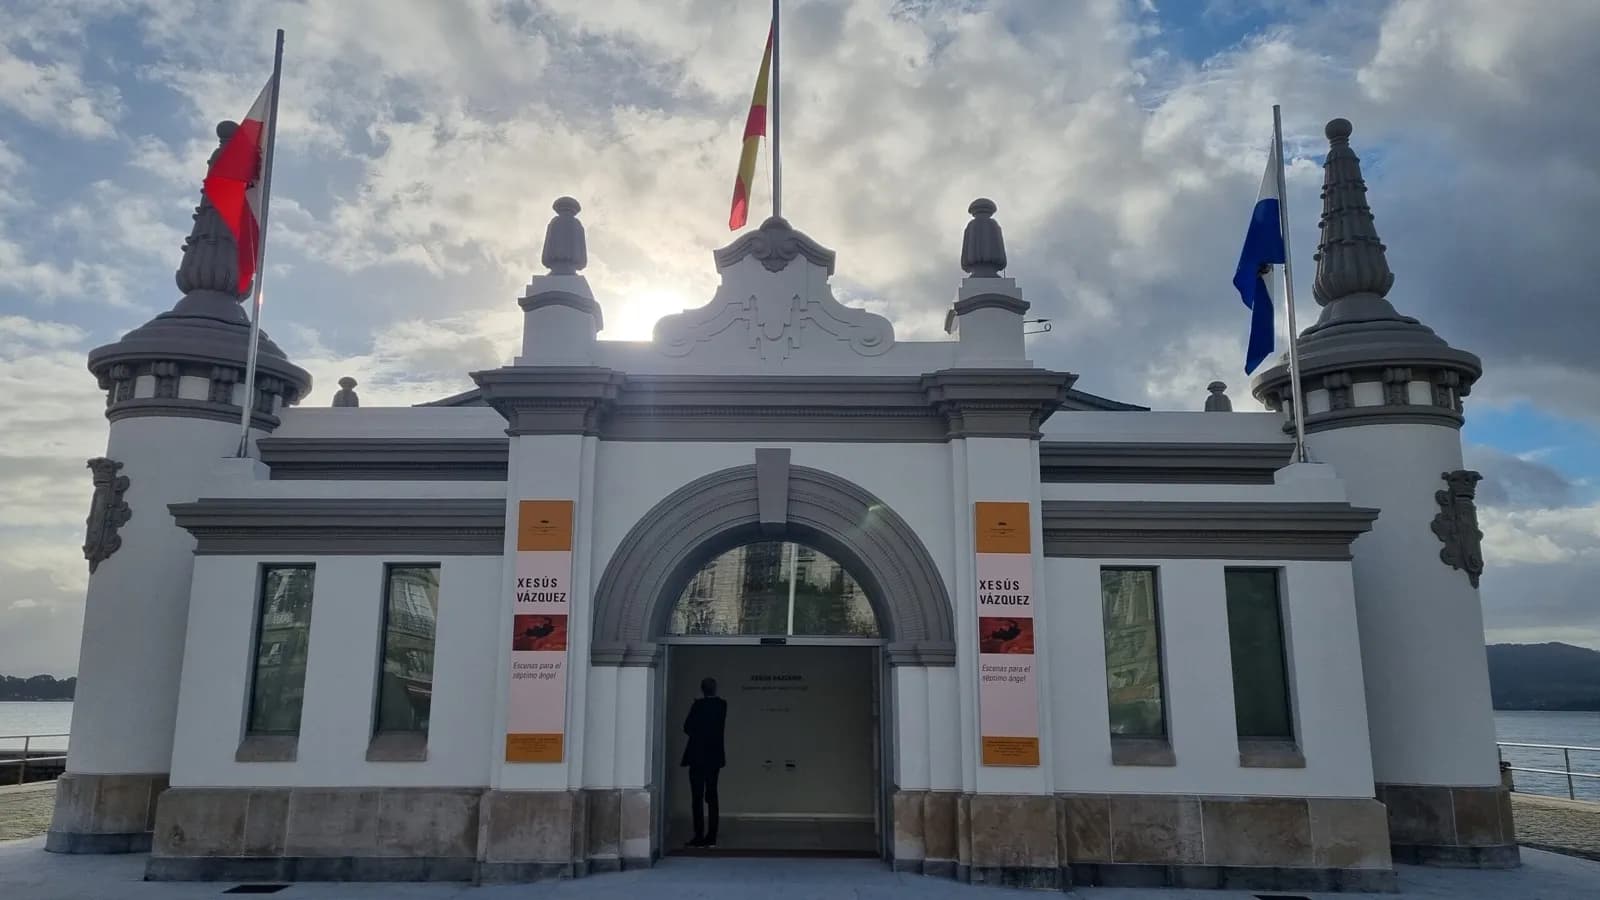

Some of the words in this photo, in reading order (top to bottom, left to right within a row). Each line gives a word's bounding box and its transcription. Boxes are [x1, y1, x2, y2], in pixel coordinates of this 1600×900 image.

[517, 575, 558, 589] XESÚS
[979, 578, 1020, 591] XESÚS
[516, 590, 567, 603] VÁZQUEZ
[979, 592, 1031, 606] VÁZQUEZ
[539, 663, 554, 671] para
[555, 661, 562, 670] el
[1008, 665, 1023, 673] para
[1024, 664, 1031, 673] el
